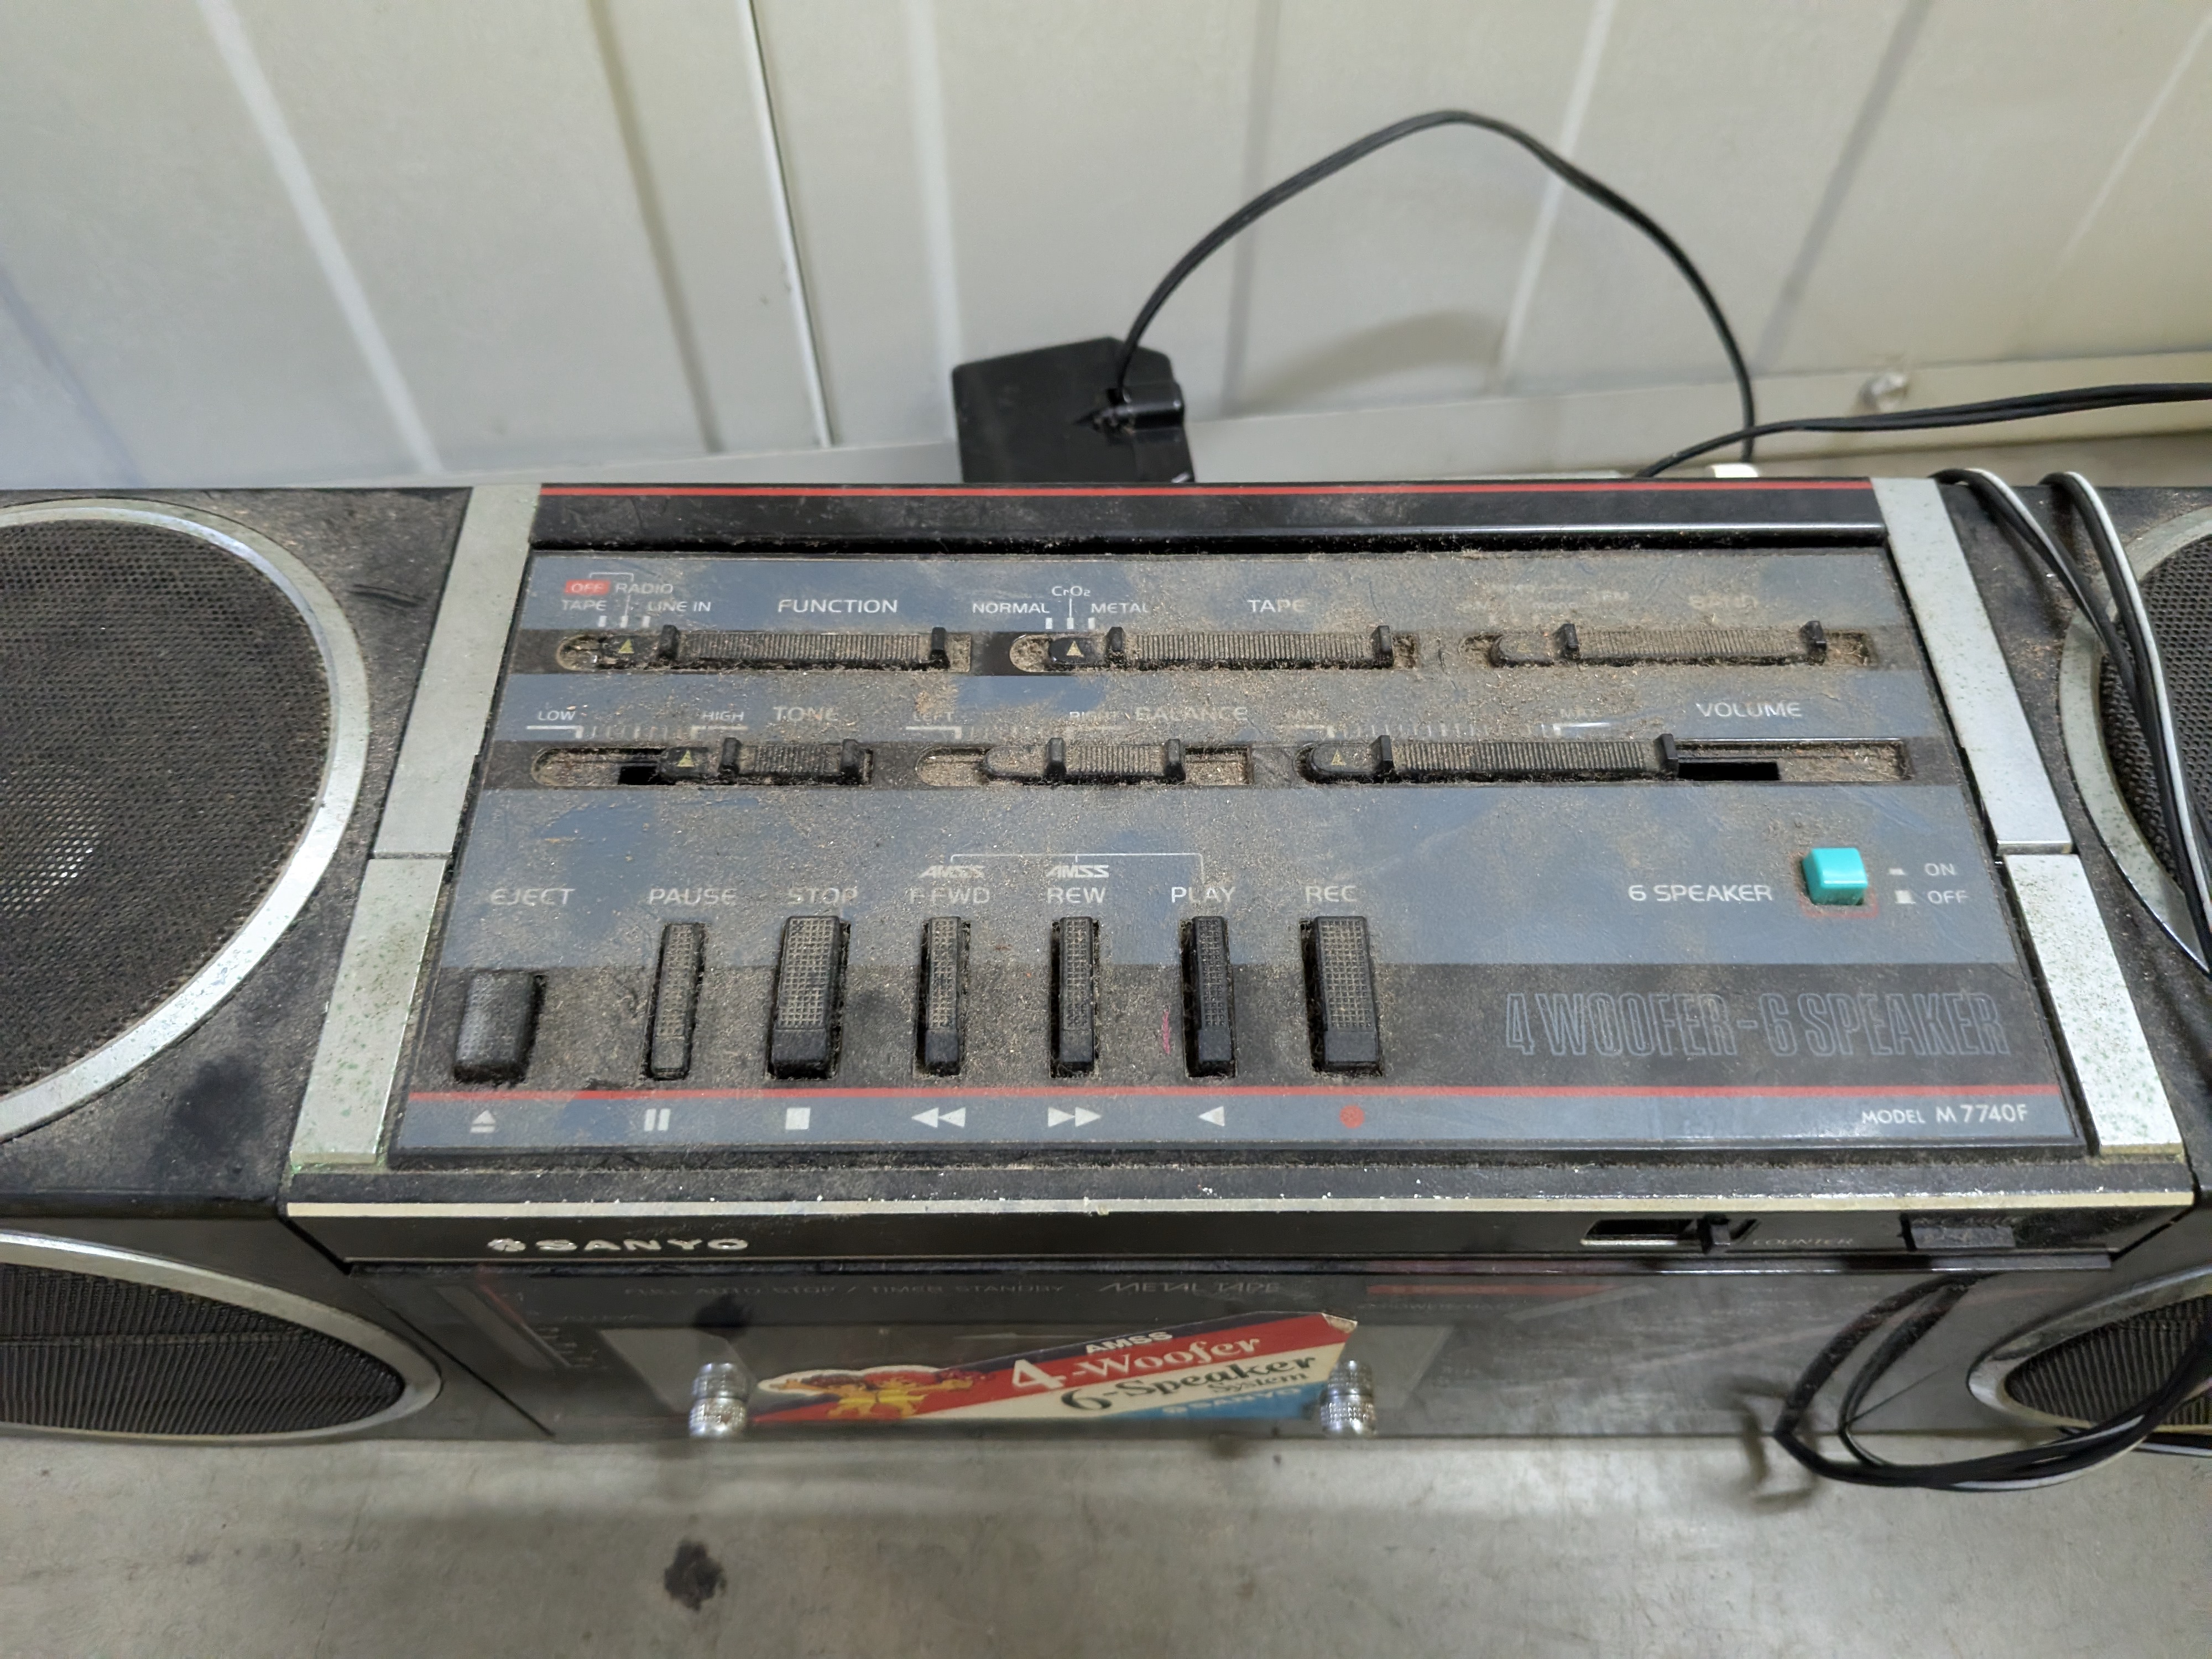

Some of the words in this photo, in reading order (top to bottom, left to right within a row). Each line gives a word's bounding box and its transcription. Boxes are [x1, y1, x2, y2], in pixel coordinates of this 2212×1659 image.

[571, 583, 603, 593] OFF
[614, 583, 674, 594] RADIO
[561, 599, 607, 612] TAPE
[647, 601, 687, 612] LINE
[693, 601, 712, 612] IN
[777, 599, 898, 613] FUNCTION
[972, 603, 1050, 614] NORMAL
[1091, 603, 1150, 614] METAL
[1248, 599, 1307, 613] TAPE
[538, 711, 576, 721] LOW
[701, 711, 745, 722] HIGH
[773, 706, 839, 722] TONE
[1695, 702, 1804, 718] VOLUME
[1047, 865, 1110, 878] AMSS
[1924, 863, 1958, 877] ON
[489, 888, 576, 905] EJECT
[647, 888, 738, 905] PAUSE
[787, 888, 860, 905] STOP
[1047, 887, 1107, 904] REW
[1170, 886, 1237, 902] PLAY
[1305, 885, 1357, 902] REC
[1653, 884, 1773, 902] SPEAKER
[1926, 890, 1970, 904] OFF
[1798, 992, 2011, 1057] SPEAKER
[1860, 1109, 1926, 1125] MODEL
[535, 1238, 749, 1251] SANYO
[1098, 1282, 1200, 1293] METAL
[1086, 1331, 1173, 1355] AMSS
